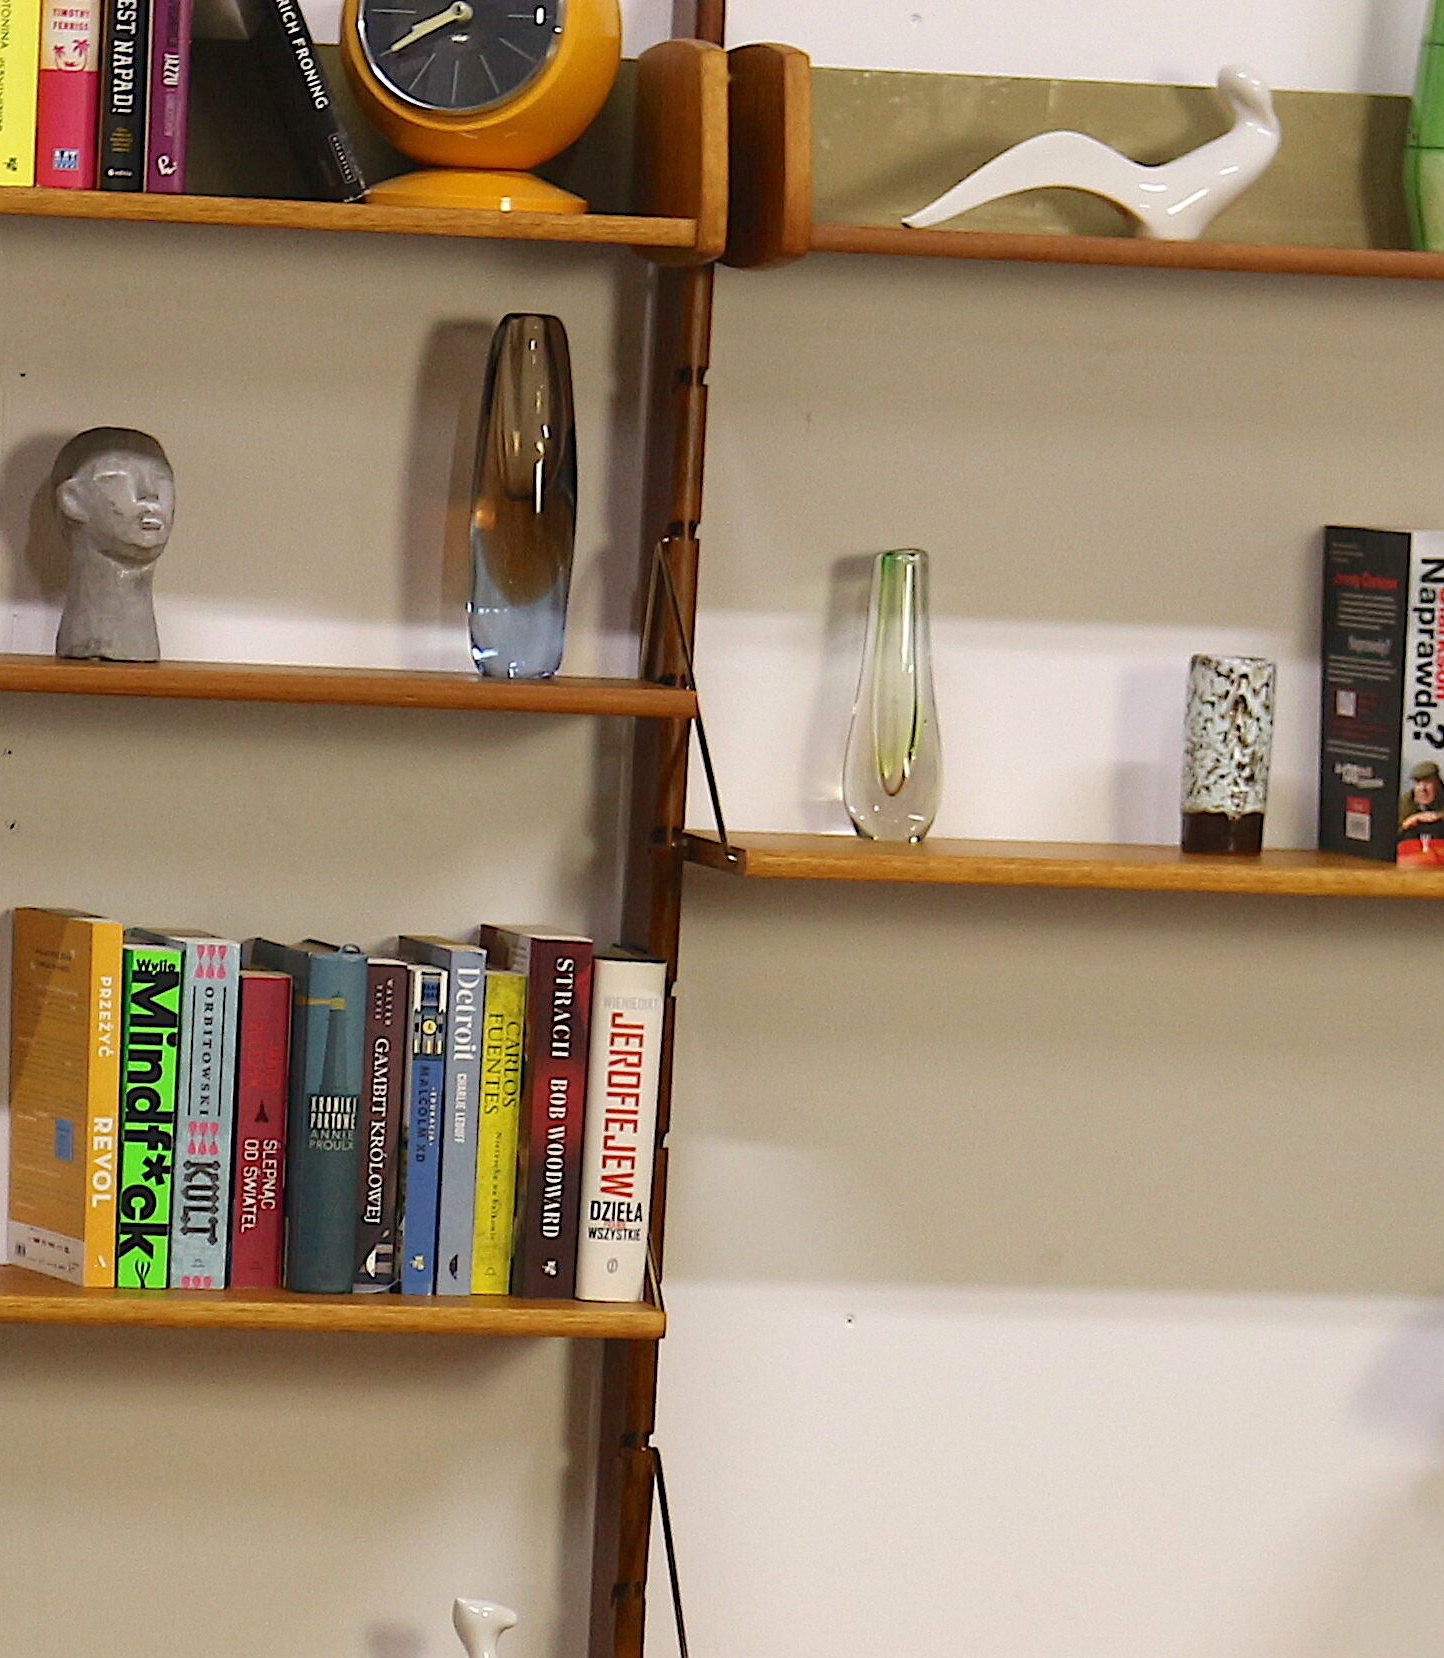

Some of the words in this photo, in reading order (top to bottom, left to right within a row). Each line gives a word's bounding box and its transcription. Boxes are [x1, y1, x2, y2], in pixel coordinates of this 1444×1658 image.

[52, 8, 90, 18] TIMOTHY
[52, 21, 89, 31] FERRISS
[112, 40, 135, 114] NAPAD!
[295, 39, 330, 111] FRONING
[97, 975, 114, 1058] PRZEŻYĆ
[453, 967, 481, 1061] Detroit
[550, 957, 575, 1058] STRACH
[199, 986, 215, 1116] ORBITOWSKI
[371, 1037, 390, 1116] GAMBIT
[484, 1013, 504, 1114] FUENTES
[503, 1021, 521, 1107] CARLOS
[310, 1096, 357, 1113] KRONIKI
[310, 1112, 355, 1129] PORTOWE
[418, 1066, 430, 1138] MALCOLM
[455, 1073, 468, 1110] CHARLIE
[549, 1077, 569, 1119] BOB
[599, 1012, 645, 1198] JEROFIEJEW
[91, 1116, 114, 1208] REVOL
[243, 1138, 260, 1162] OD
[308, 1138, 354, 1151] PROULX
[310, 1129, 354, 1140] ANNIE
[415, 1144, 427, 1163] XD
[179, 1159, 222, 1246] KULT
[241, 1166, 260, 1233] ŚWIATEŁ
[259, 1138, 281, 1210] ŚLEPNĄC
[363, 1121, 388, 1225] KRÓLOWEJ
[542, 1124, 567, 1239] WOODWARD
[588, 1226, 641, 1241] WSZYSTKIE
[590, 1200, 643, 1222] DZIEŁA
